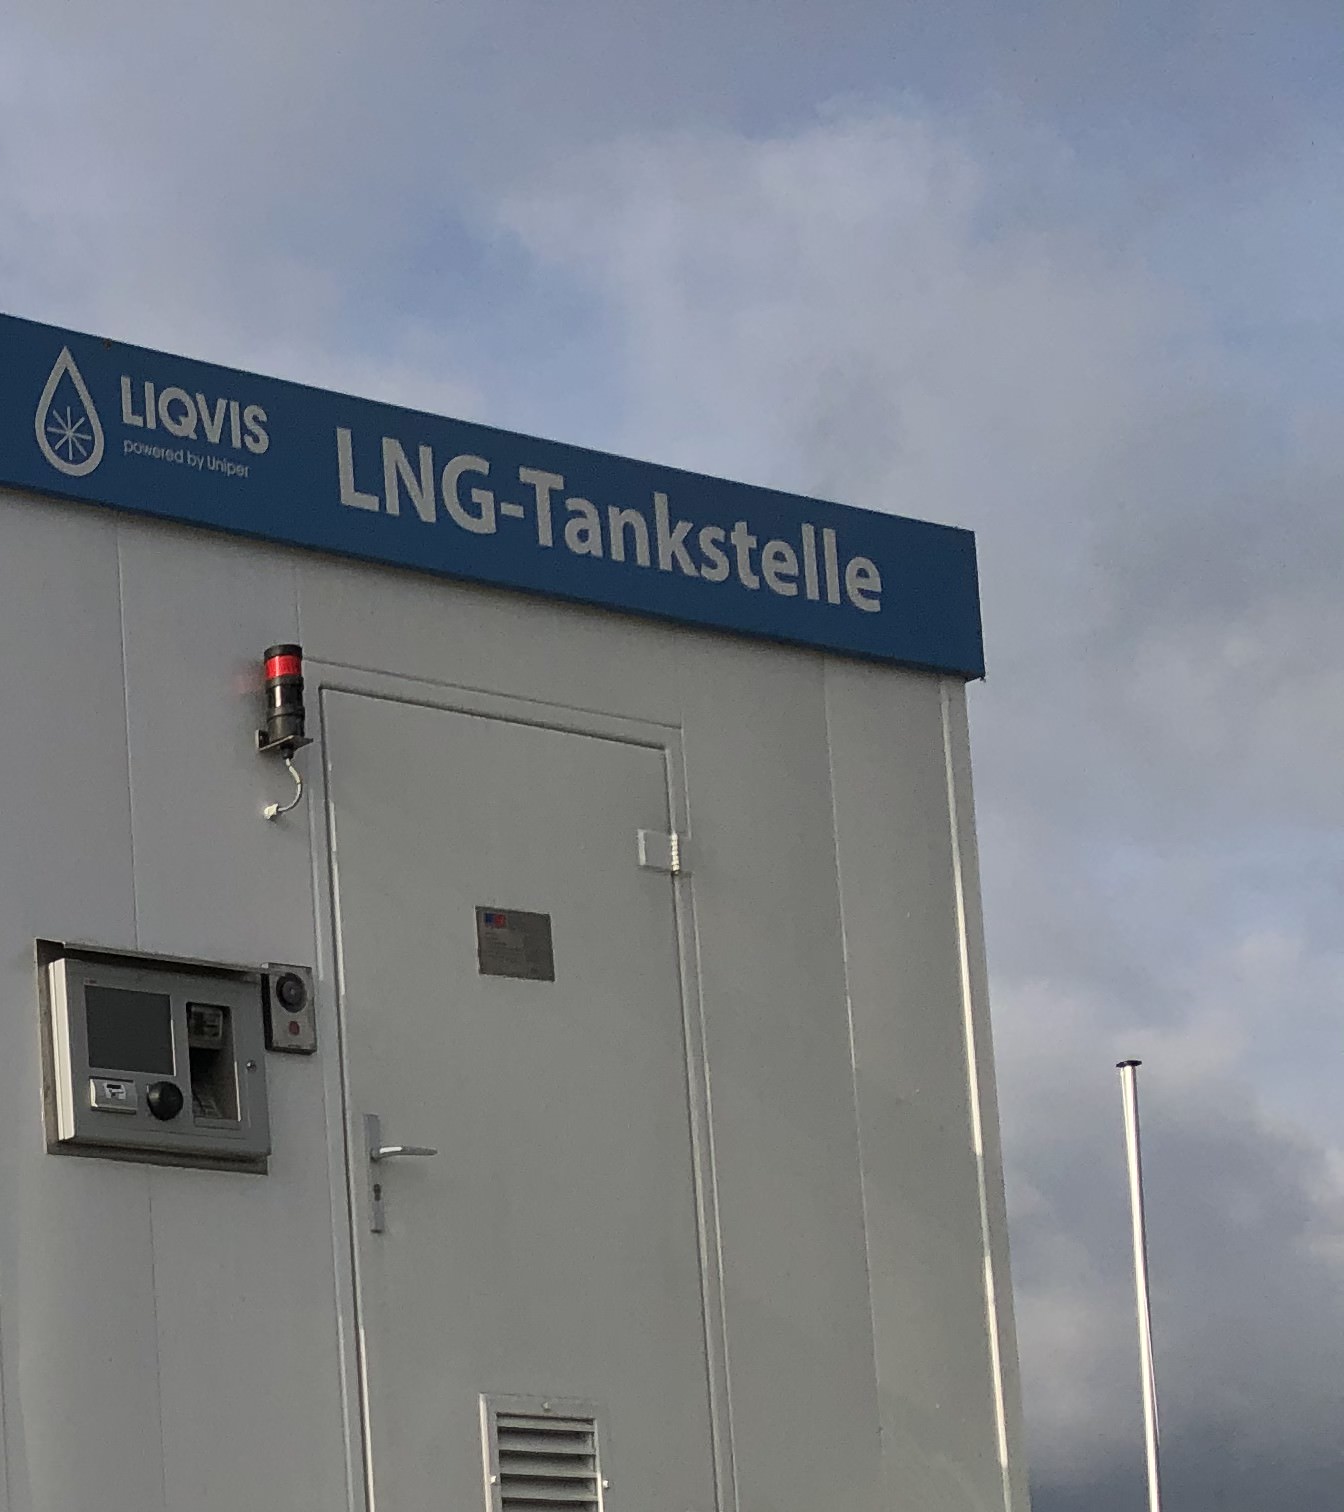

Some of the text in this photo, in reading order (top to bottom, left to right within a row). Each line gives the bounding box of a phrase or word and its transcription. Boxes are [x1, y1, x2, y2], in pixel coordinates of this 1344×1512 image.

[121, 375, 269, 454] LIQVIS
[123, 439, 250, 478] powered by Uniper
[335, 426, 883, 613] LNG-Tankstelle
